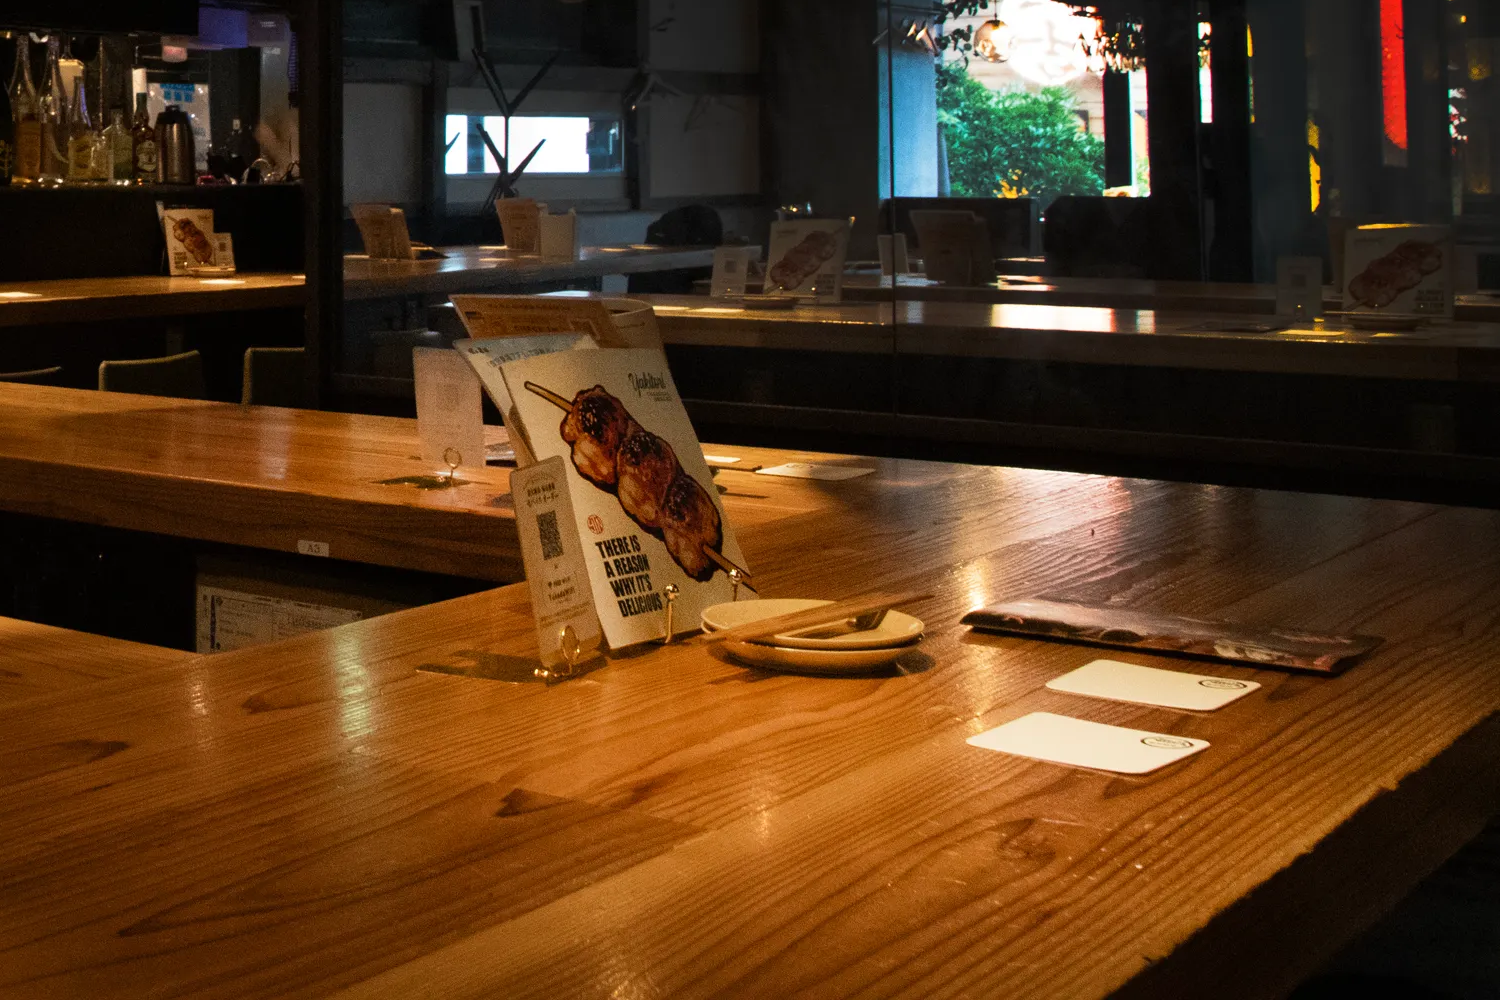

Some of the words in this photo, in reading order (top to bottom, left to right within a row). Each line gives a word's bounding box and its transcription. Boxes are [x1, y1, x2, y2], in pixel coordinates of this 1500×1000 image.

[595, 535, 631, 558] THERE
[629, 534, 642, 552] IS
[603, 560, 616, 578] A
[614, 553, 651, 577] REASON
[609, 576, 637, 597] WHY
[636, 573, 653, 593] IT'S
[617, 592, 664, 618] DELICIOUS
